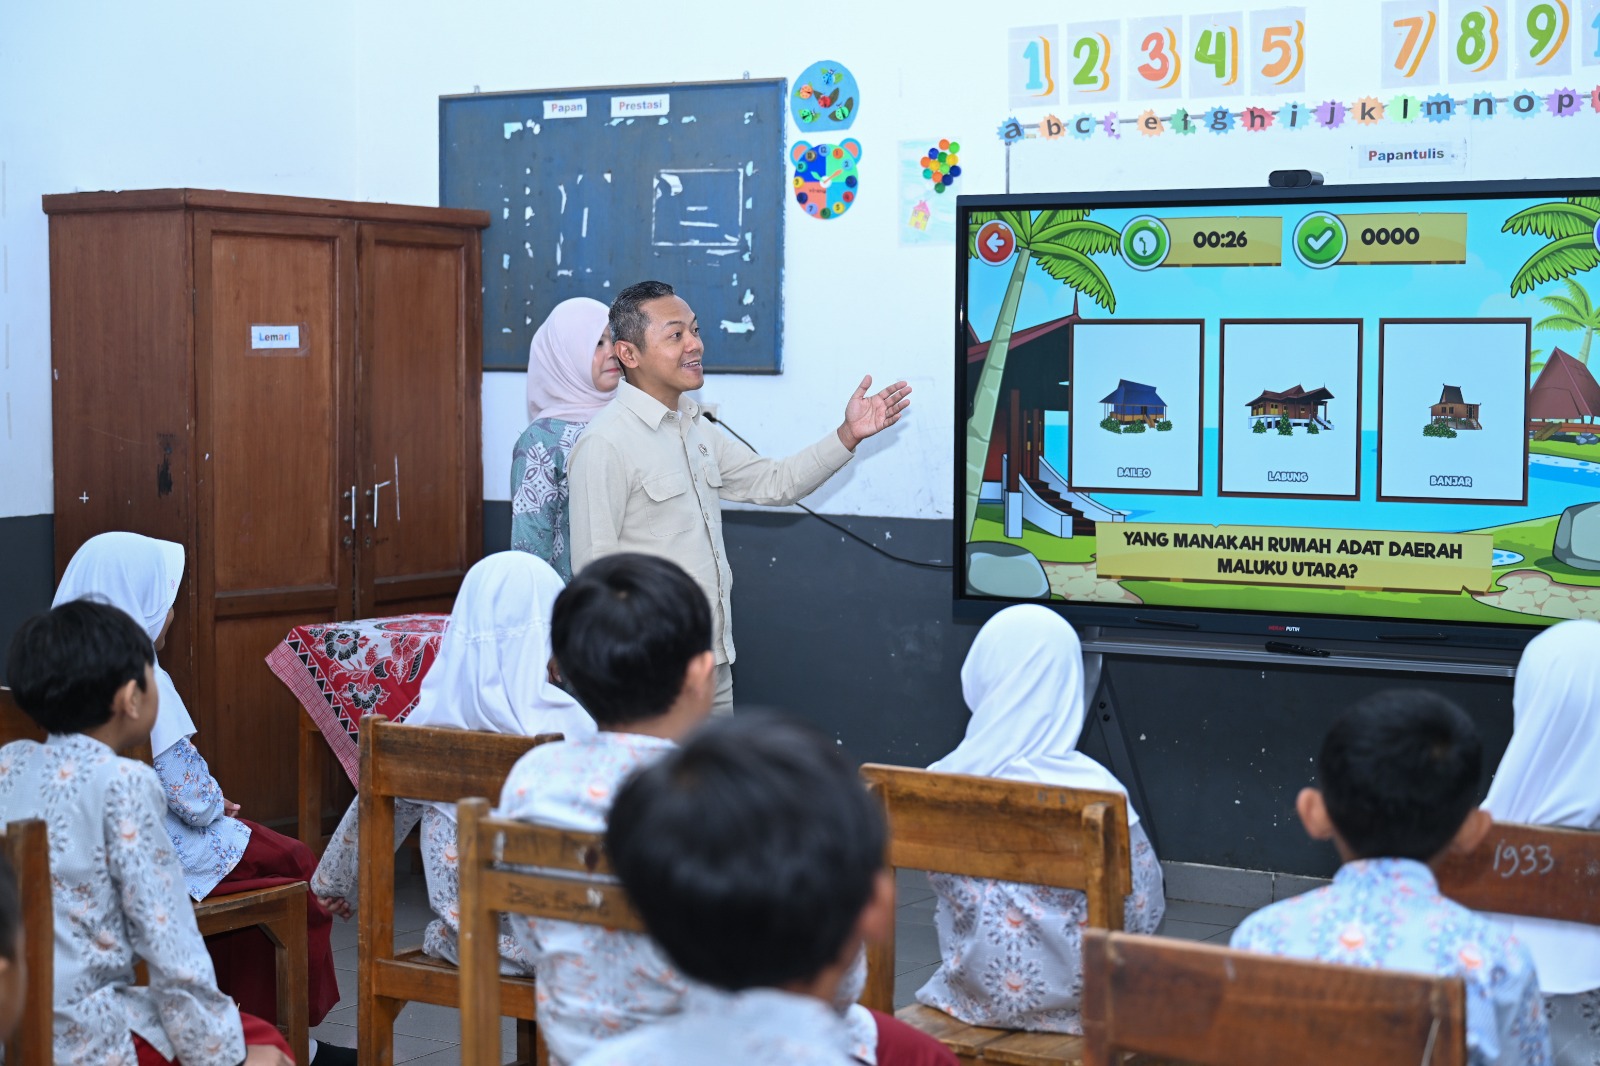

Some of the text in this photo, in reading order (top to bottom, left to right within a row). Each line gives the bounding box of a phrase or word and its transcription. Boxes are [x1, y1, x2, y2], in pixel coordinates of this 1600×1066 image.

[1023, 41, 1043, 90] 1
[1073, 37, 1099, 85] 2
[1138, 32, 1169, 81] 3
[1194, 29, 1226, 78] 4
[1261, 26, 1292, 77] 5
[1393, 16, 1424, 70] 7
[1456, 11, 1486, 65] 8
[1526, 3, 1556, 58] 9
[551, 99, 662, 114] Papan Prestasi
[1004, 122, 1022, 139] a
[1047, 119, 1061, 136] b
[1075, 117, 1090, 133] c
[1144, 116, 1158, 130] e
[1211, 110, 1228, 130] g
[1250, 110, 1265, 128] h
[1290, 104, 1298, 127] i
[1325, 101, 1336, 125] j
[1360, 102, 1376, 120] k
[1426, 99, 1451, 116] m
[1473, 97, 1493, 115] n
[1513, 94, 1535, 112] o
[1557, 93, 1574, 113] p
[1368, 148, 1444, 163] Papantulis
[1193, 230, 1248, 248] 00:26
[1361, 227, 1420, 246] 0000
[259, 332, 290, 342] Lemari
[1117, 467, 1151, 478] BAILEO
[1268, 471, 1308, 482] LABUNG
[1430, 475, 1472, 487] BANJAR
[1123, 531, 1462, 559] YANG MANAKAH RUMAH ADAT DAERAH
[1217, 558, 1358, 579] MALUKU UTARA?
[1493, 839, 1554, 878] 1933
